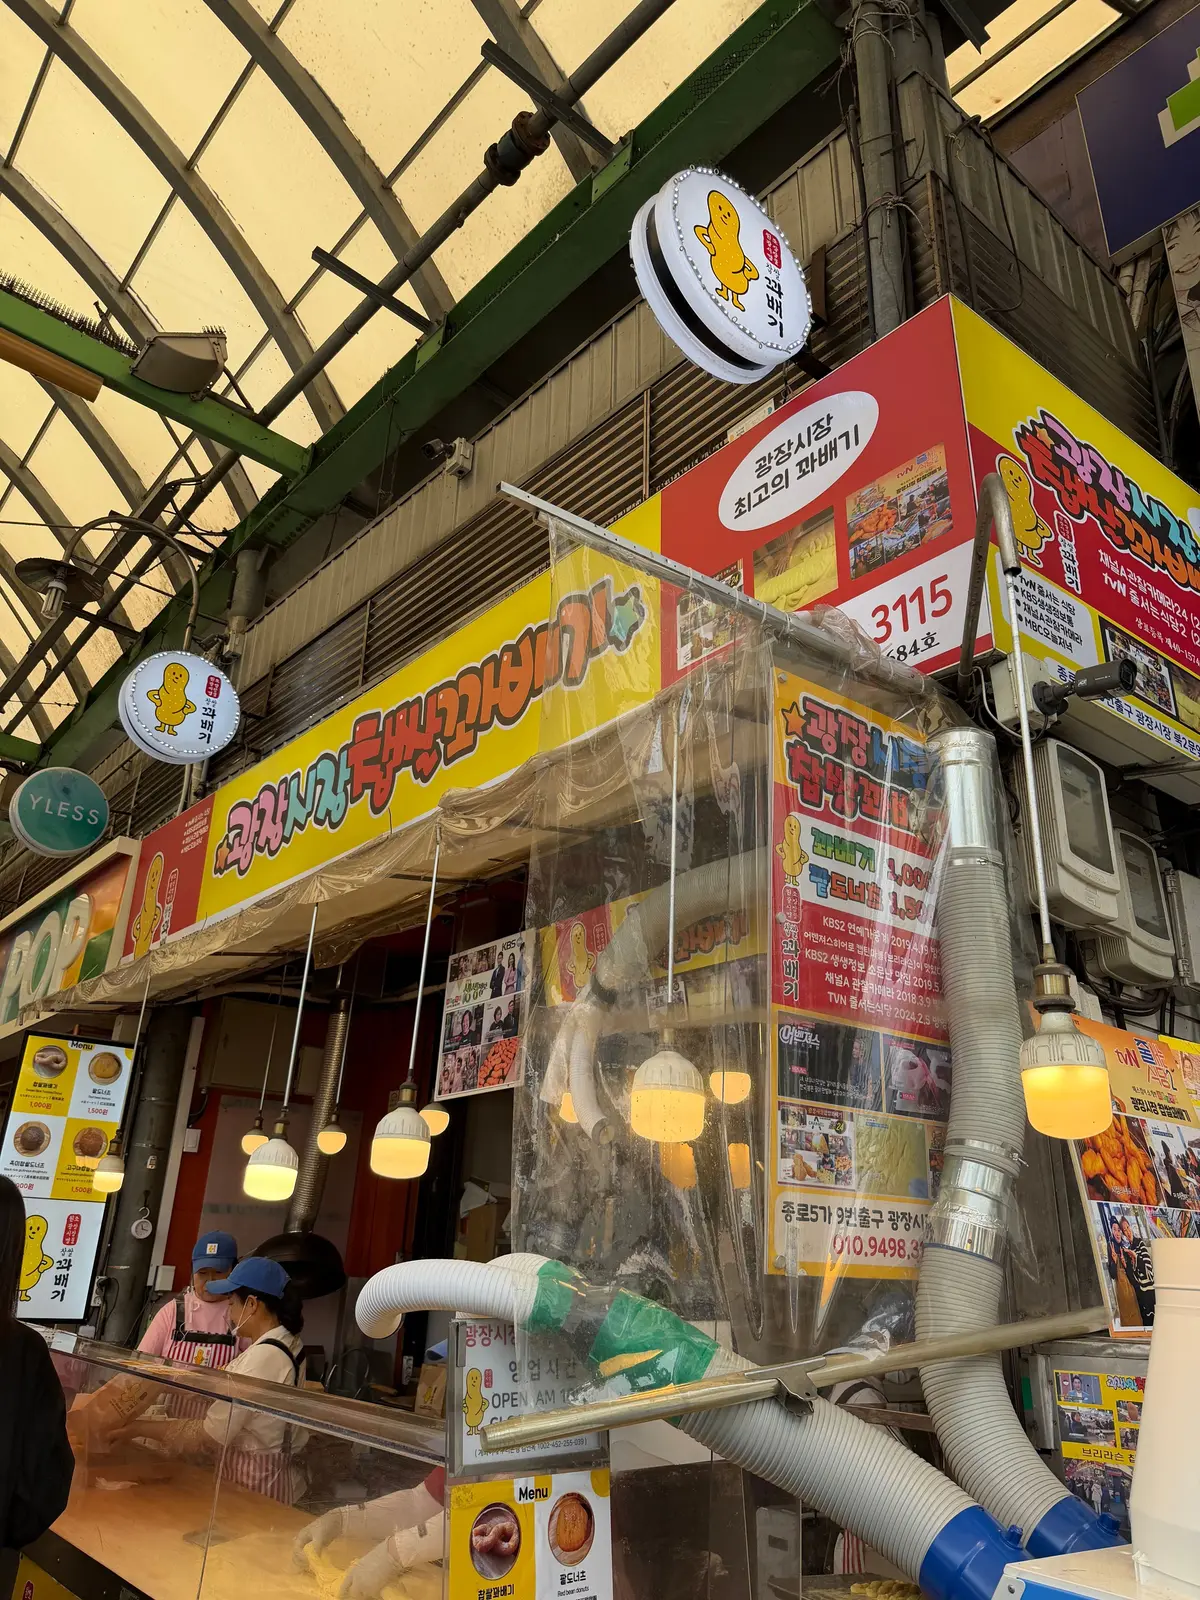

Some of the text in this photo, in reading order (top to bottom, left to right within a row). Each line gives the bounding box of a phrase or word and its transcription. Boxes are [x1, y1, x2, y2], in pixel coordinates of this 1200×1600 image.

[755, 413, 833, 479] 광장시장
[733, 468, 790, 520] 최고의
[796, 424, 860, 481] 꽈배기
[1042, 412, 1198, 564] 광장시장
[1019, 574, 1036, 591] tvN
[1103, 572, 1127, 597] tvN
[871, 574, 953, 644] 3115
[1024, 616, 1074, 653] MBC오늘저녁
[198, 706, 216, 744] 꽈배기
[1136, 709, 1172, 741] 광장시장
[29, 794, 100, 825] YLESS
[226, 748, 351, 872] 광장시장
[811, 827, 875, 872] 꽈배기
[501, 939, 516, 952] KBS
[823, 916, 846, 932] KBS2
[891, 935, 929, 955] 2019.4.19
[782, 939, 800, 1001] 꽈배기
[805, 948, 829, 964] KBS2
[831, 955, 866, 973] 생생정보
[868, 964, 893, 982] 소문난
[825, 972, 850, 989] 채널A
[897, 989, 931, 1008] 2018.3.9
[828, 991, 847, 1006] TVN
[894, 1007, 930, 1026] 2024.2.5
[70, 1040, 94, 1050] Menu
[780, 1025, 820, 1047] 어벤져스
[1115, 1047, 1140, 1069] tvN
[781, 1201, 833, 1225] 종로5가
[836, 1207, 885, 1229] 9번출구
[50, 1259, 73, 1302] 꽈배기
[491, 1392, 528, 1409] OPEN
[537, 1390, 556, 1406] AM
[1082, 1447, 1124, 1462] 브리라슨
[518, 1486, 549, 1502] Menu
[557, 1590, 566, 1598] Red
[566, 1588, 576, 1597] bean
[576, 1586, 589, 1595] donuts
